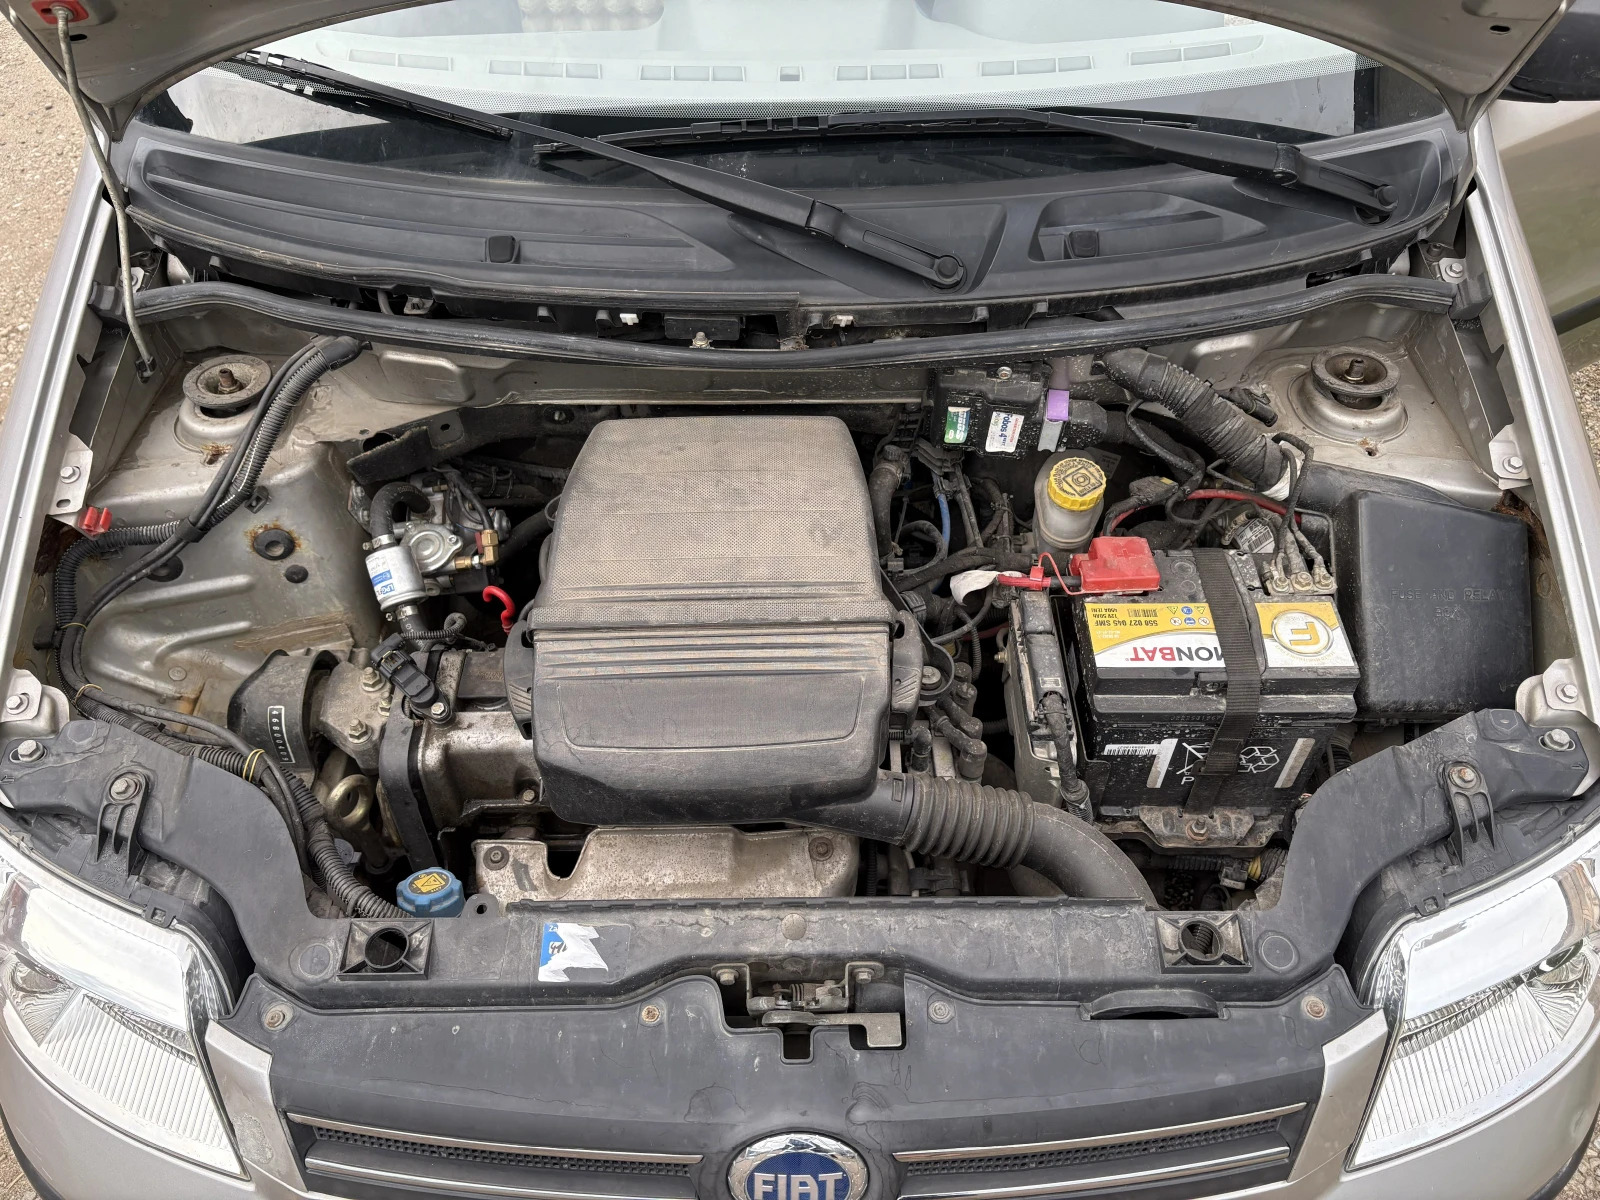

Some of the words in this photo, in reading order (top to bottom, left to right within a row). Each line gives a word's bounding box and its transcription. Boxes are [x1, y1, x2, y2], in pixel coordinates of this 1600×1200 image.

[1390, 589, 1422, 600] FUSE
[1430, 589, 1455, 601] AND
[1463, 588, 1505, 601] RELAY
[1435, 606, 1460, 618] BOX
[1094, 619, 1111, 627] SMF
[753, 1172, 844, 1200] FIAT
